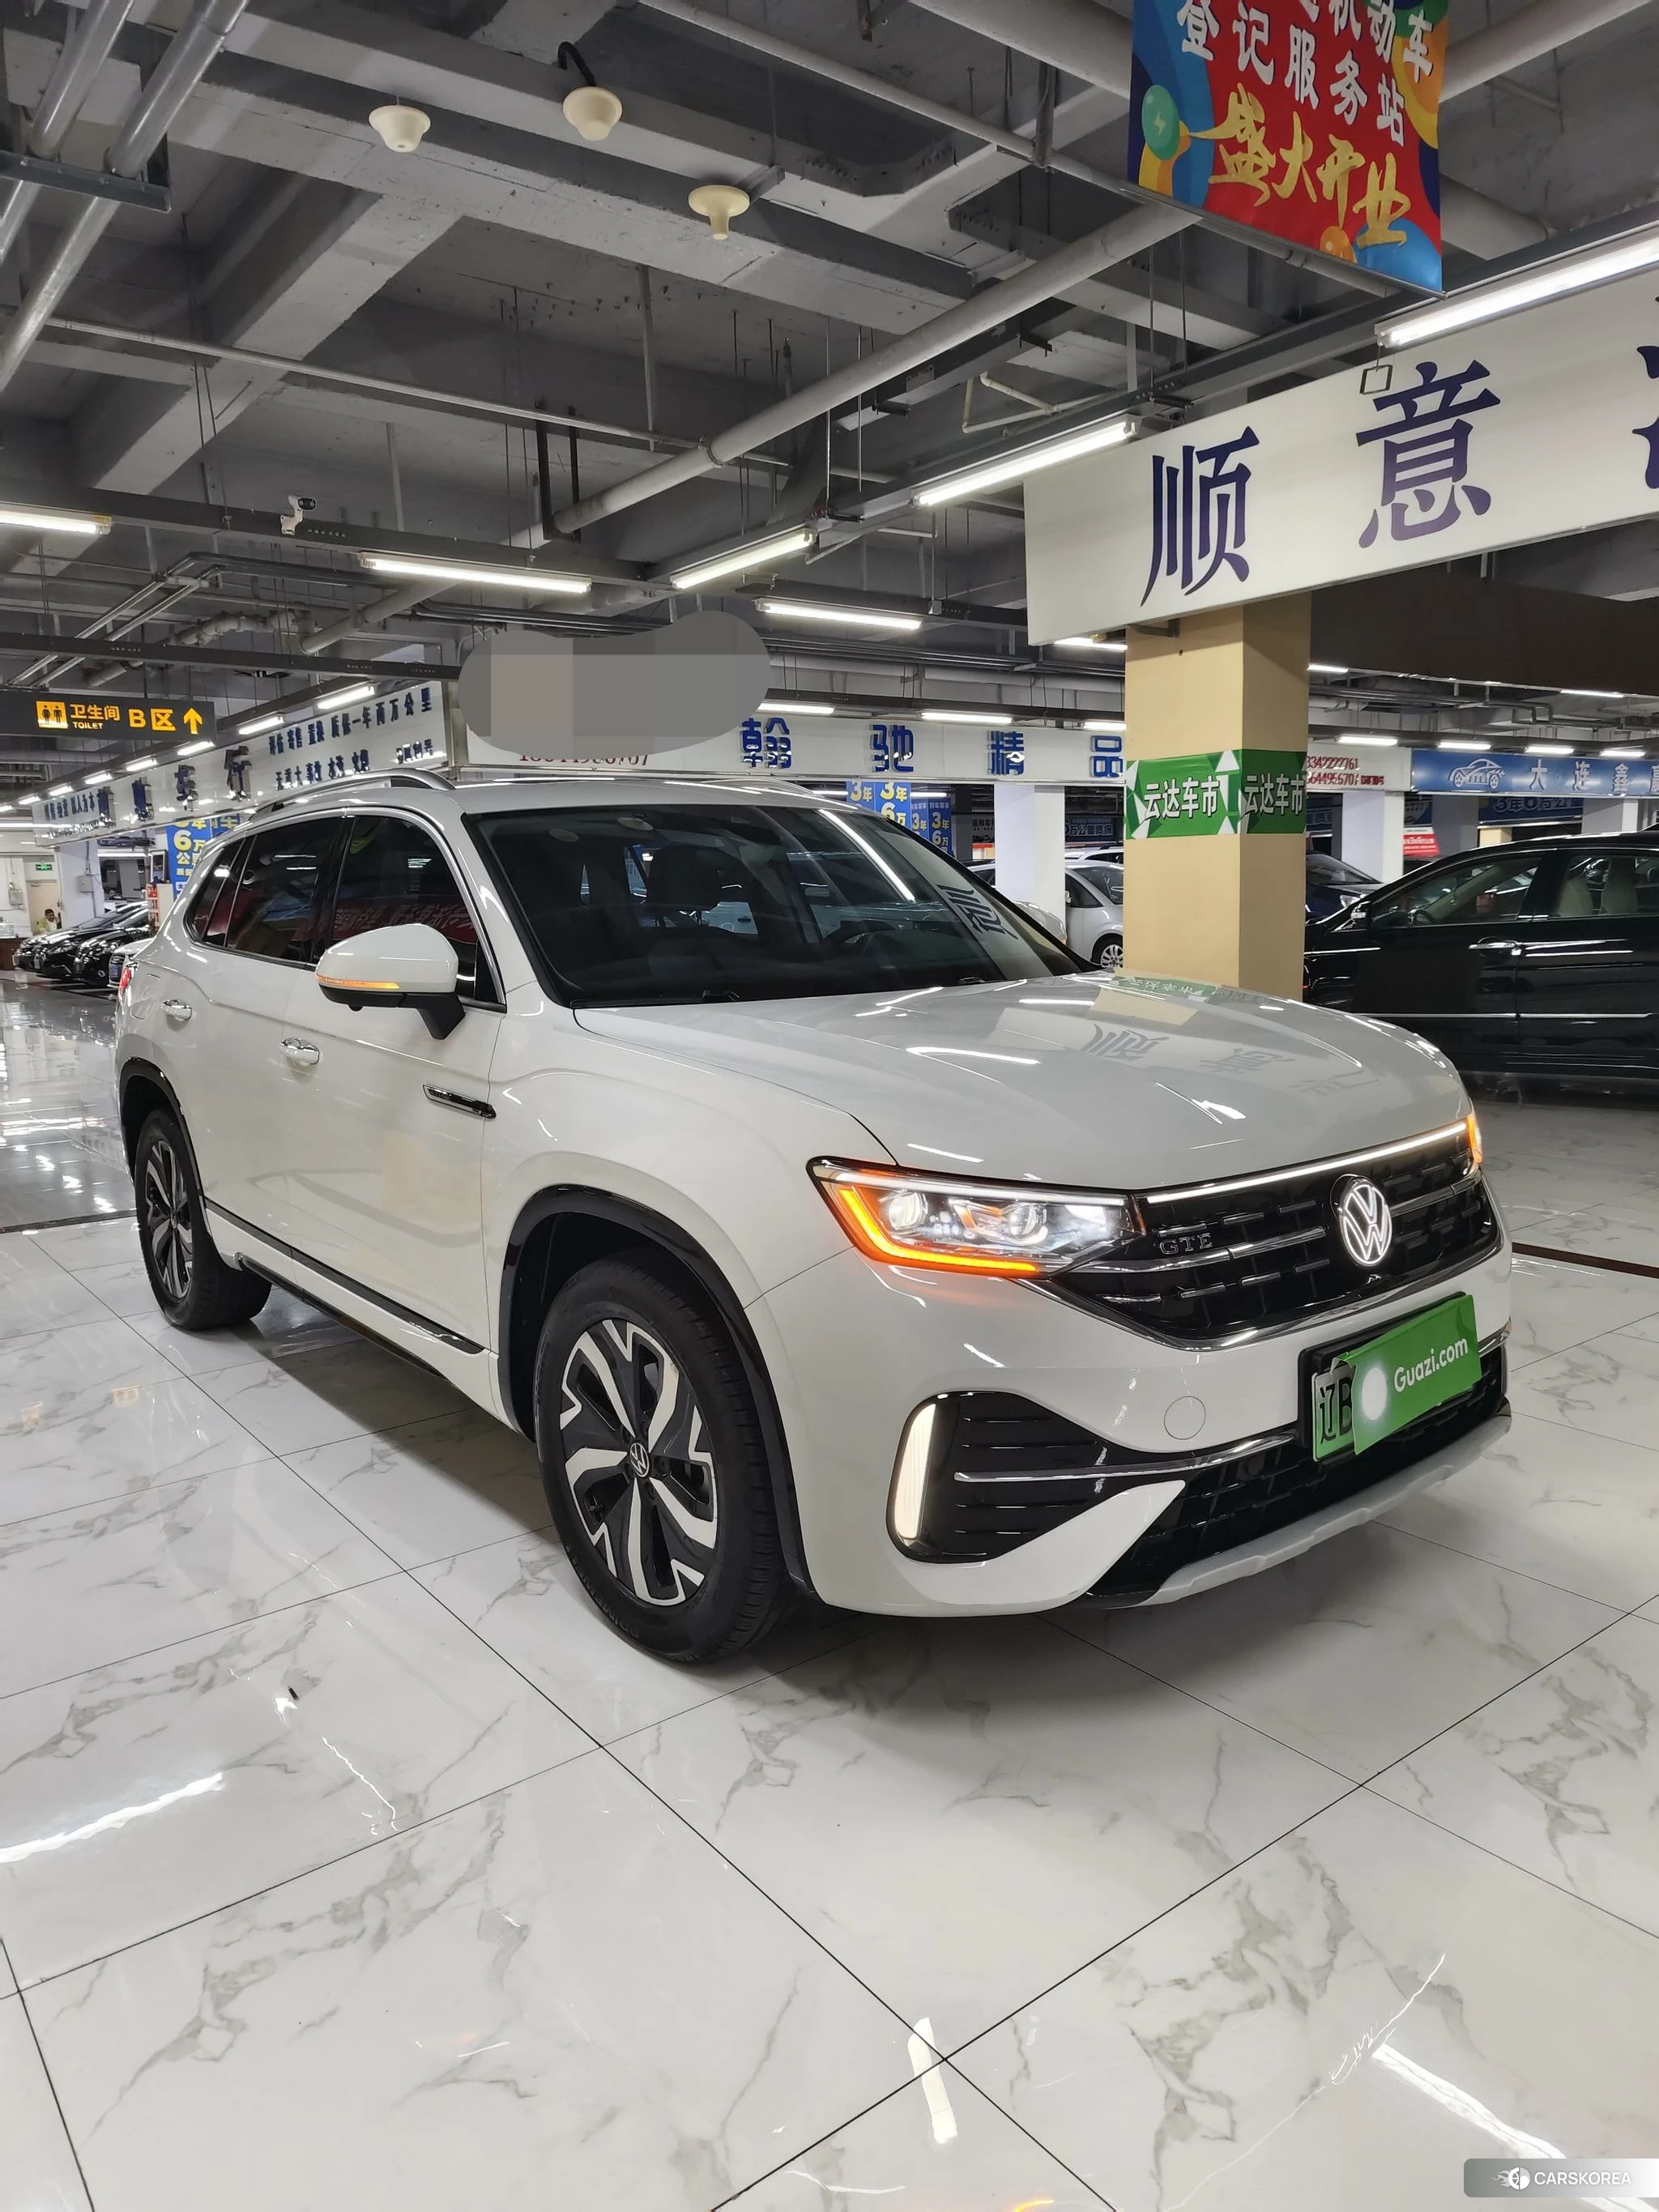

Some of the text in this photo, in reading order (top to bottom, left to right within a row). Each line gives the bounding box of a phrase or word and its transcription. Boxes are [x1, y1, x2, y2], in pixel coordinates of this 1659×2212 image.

[1299, 0, 1433, 83] 机动车
[1177, 0, 1405, 146] 登记服务站
[1189, 83, 1412, 249] 盛大开业
[1140, 344, 1659, 608] 顺意
[70, 703, 176, 731] 卫生间 B 区
[72, 721, 104, 729] TOILET
[740, 717, 1124, 778] 翰驰精品
[1144, 774, 1221, 820] 云达车市
[1244, 773, 1305, 816] 云达车市
[912, 812, 927, 830] 3年
[932, 812, 949, 829] 3年
[932, 829, 949, 846] 6万
[1159, 1232, 1213, 1255] GTE
[1393, 1338, 1468, 1393] Guazi.com
